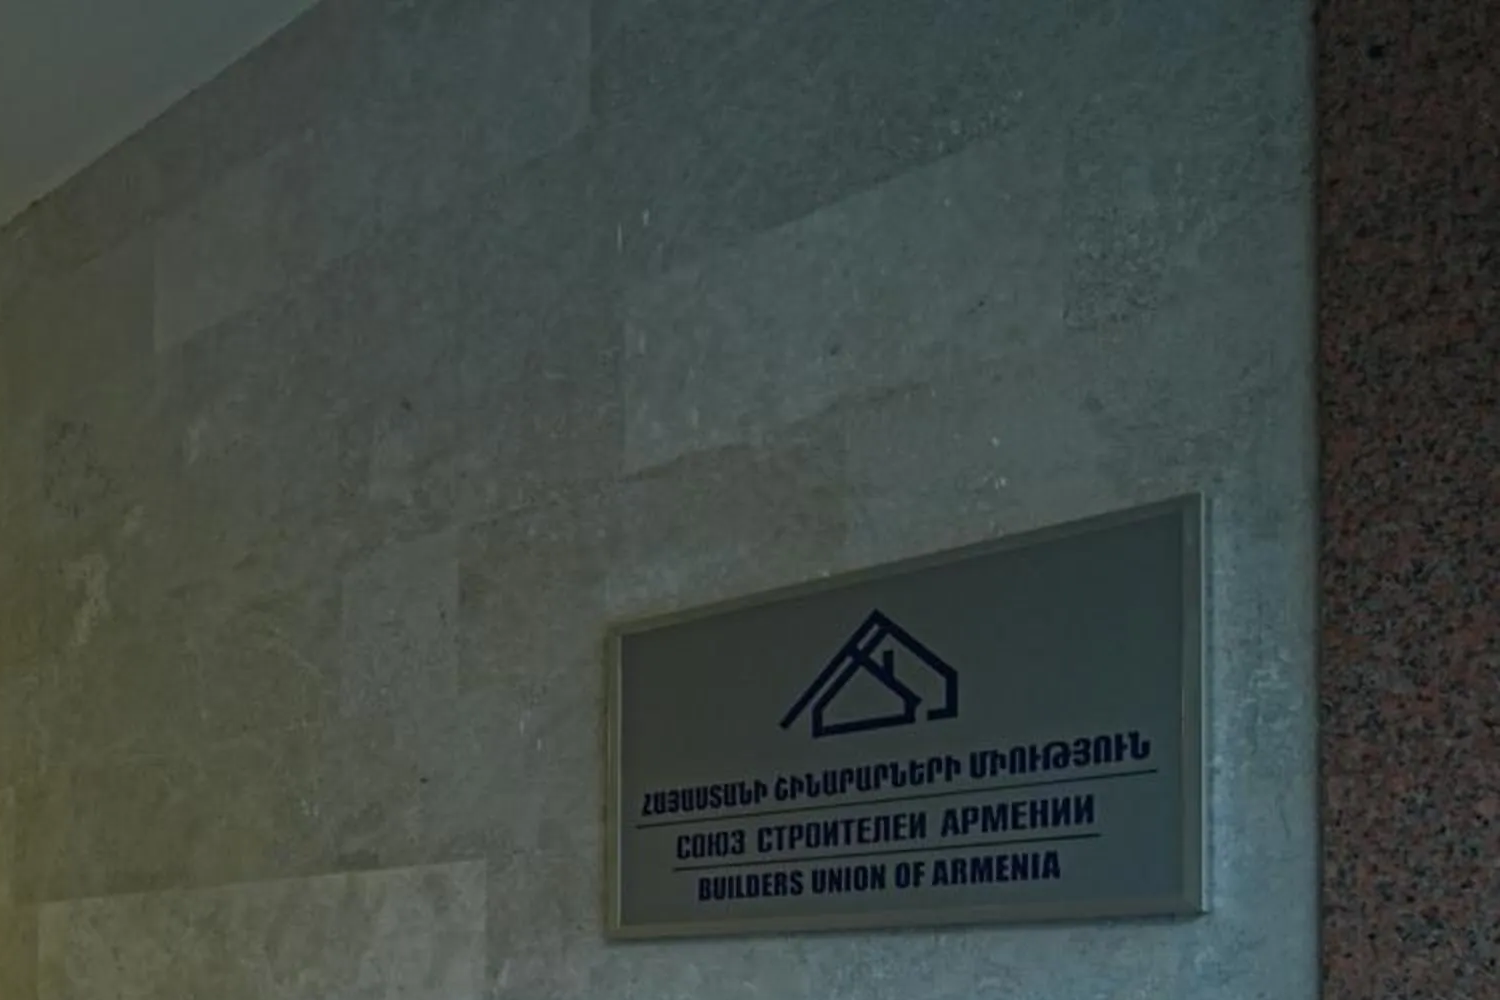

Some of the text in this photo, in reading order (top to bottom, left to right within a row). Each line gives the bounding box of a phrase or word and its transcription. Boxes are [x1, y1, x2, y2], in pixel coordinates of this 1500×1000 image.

[641, 730, 1152, 817] ՀԱՅԱՍՏԱՆԻ ՇԻՆԱՐԱՐՆԵՐԻ ՄԻՈՒԹՅՈՒՆ
[676, 829, 746, 860] СОЮЗ
[940, 794, 1095, 838] АРМЕНИИ
[698, 850, 1061, 901] BUILDERS UNION OF ARMENIA
